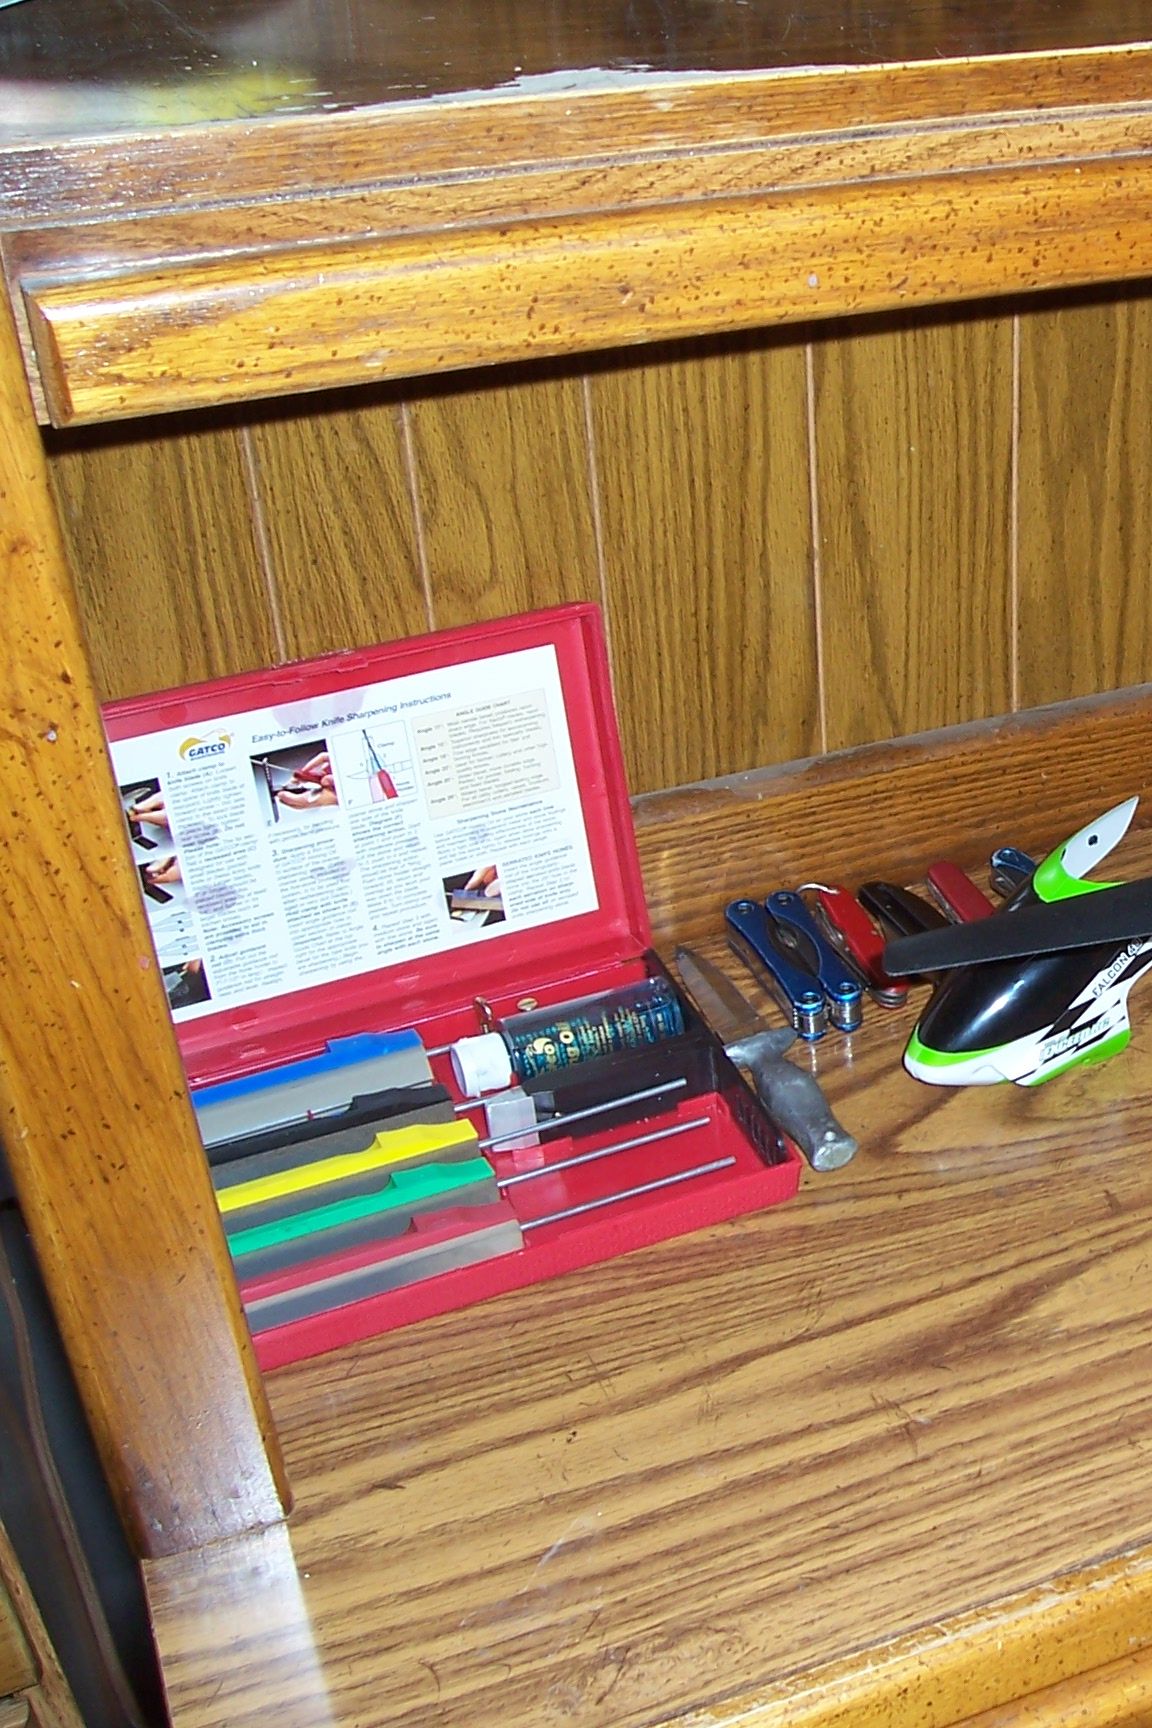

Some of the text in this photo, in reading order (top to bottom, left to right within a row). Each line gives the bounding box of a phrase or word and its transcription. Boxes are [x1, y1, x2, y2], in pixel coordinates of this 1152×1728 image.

[251, 692, 452, 743] Easy-to-Follow Knife Sharpening Instructions
[188, 742, 226, 758] GATCO
[1091, 953, 1129, 998] FALCON
